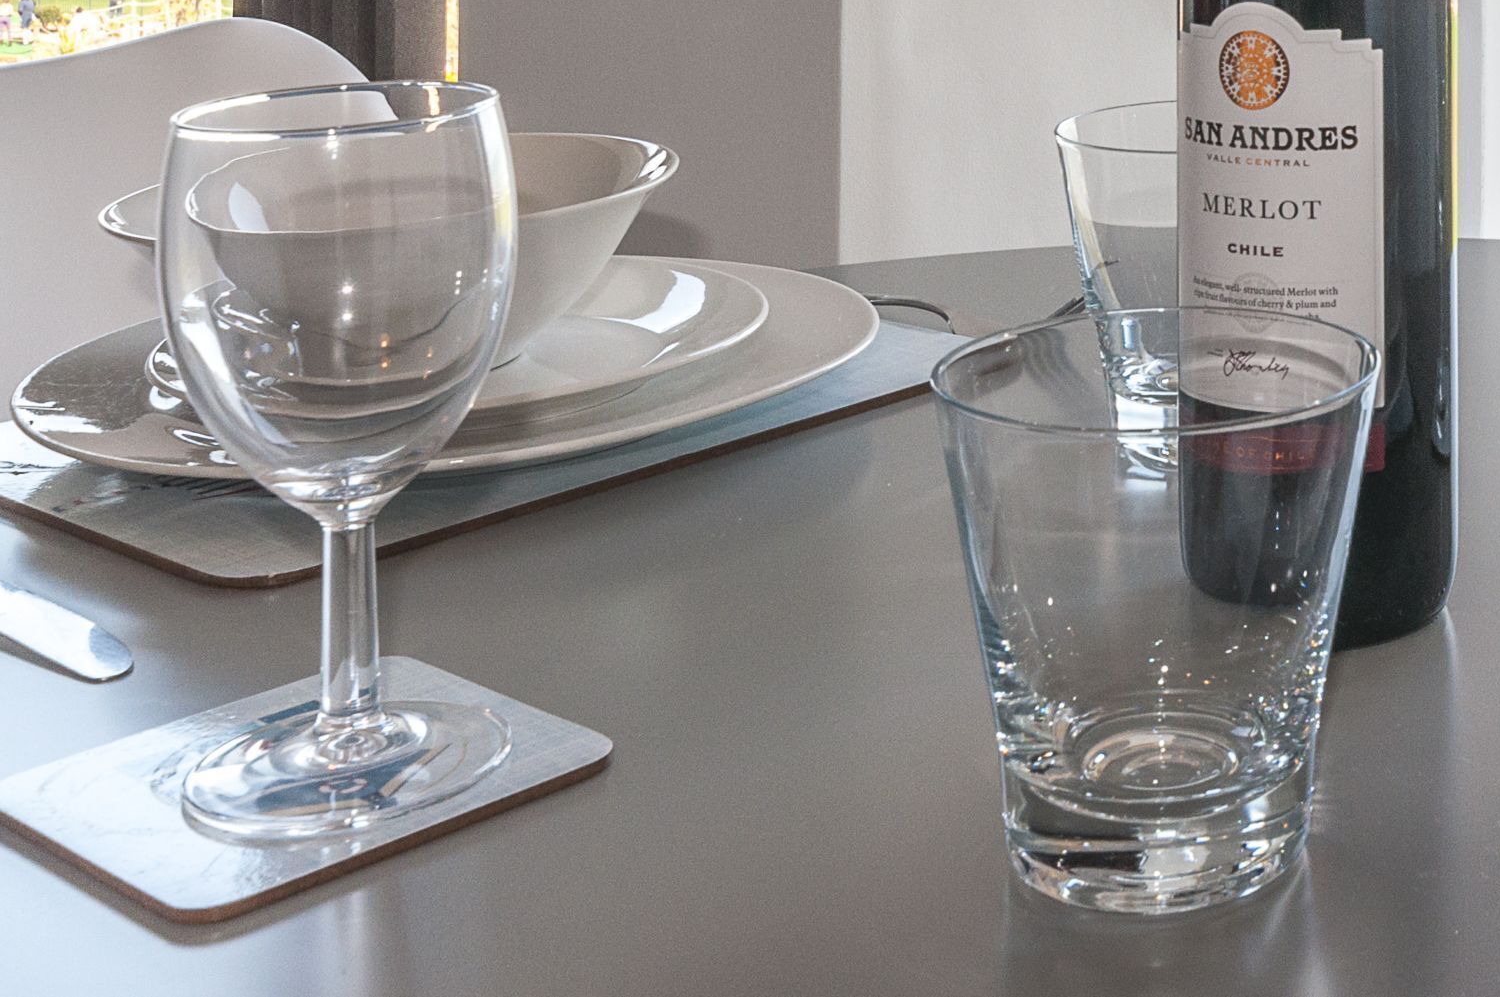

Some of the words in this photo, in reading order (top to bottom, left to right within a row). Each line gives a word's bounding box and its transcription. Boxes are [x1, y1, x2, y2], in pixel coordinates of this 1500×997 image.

[1184, 116, 1223, 146] SAN
[1229, 125, 1359, 151] ANDRES
[1207, 153, 1241, 165] VALLE
[1246, 157, 1310, 167] CENTRAL
[1202, 192, 1322, 220] MERLOT
[1227, 243, 1284, 257] CHILE
[1243, 285, 1285, 297] structured
[1287, 287, 1317, 297] Merlot
[1318, 286, 1339, 296] with
[1248, 297, 1257, 307] of
[1257, 298, 1285, 310] cherry
[1286, 300, 1293, 309] &
[1295, 300, 1318, 311] plum
[1320, 299, 1337, 308] and
